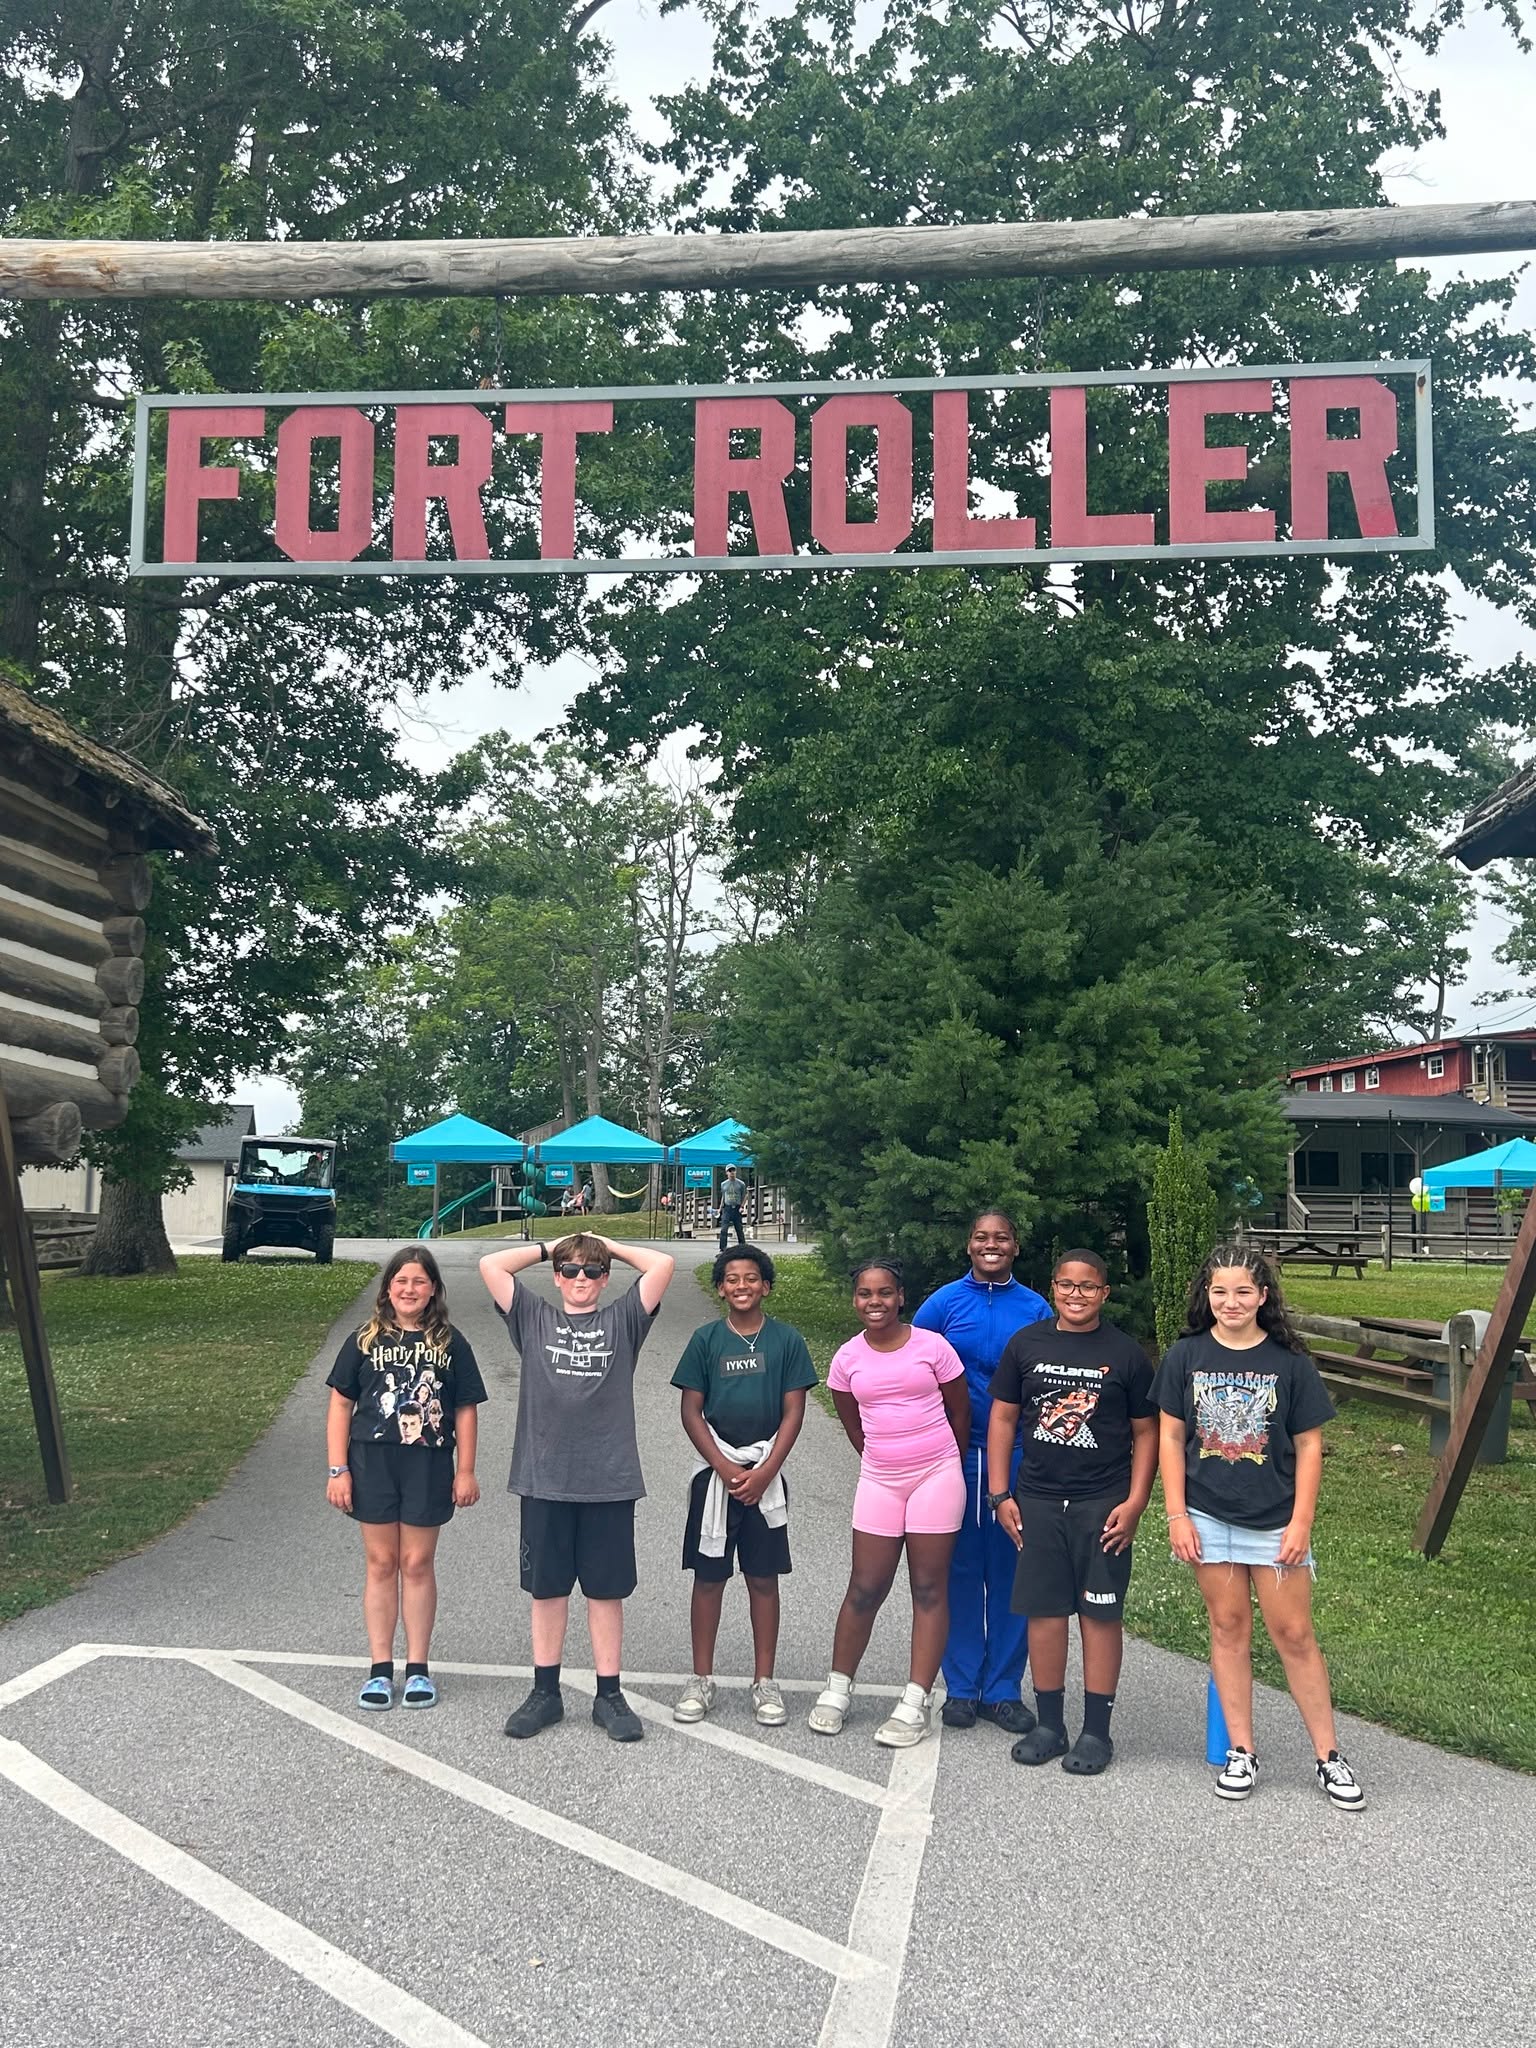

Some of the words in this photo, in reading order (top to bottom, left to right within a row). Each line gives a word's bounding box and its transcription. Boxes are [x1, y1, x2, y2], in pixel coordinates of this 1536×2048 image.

[163, 402, 614, 563] FORT
[694, 376, 1399, 557] ROLLER
[369, 1345, 414, 1371] Harry
[726, 1358, 758, 1371] IYKYK
[1033, 1362, 1104, 1379] McLaren
[1043, 1377, 1076, 1386] FORMULA
[1085, 1381, 1102, 1389] TEAM
